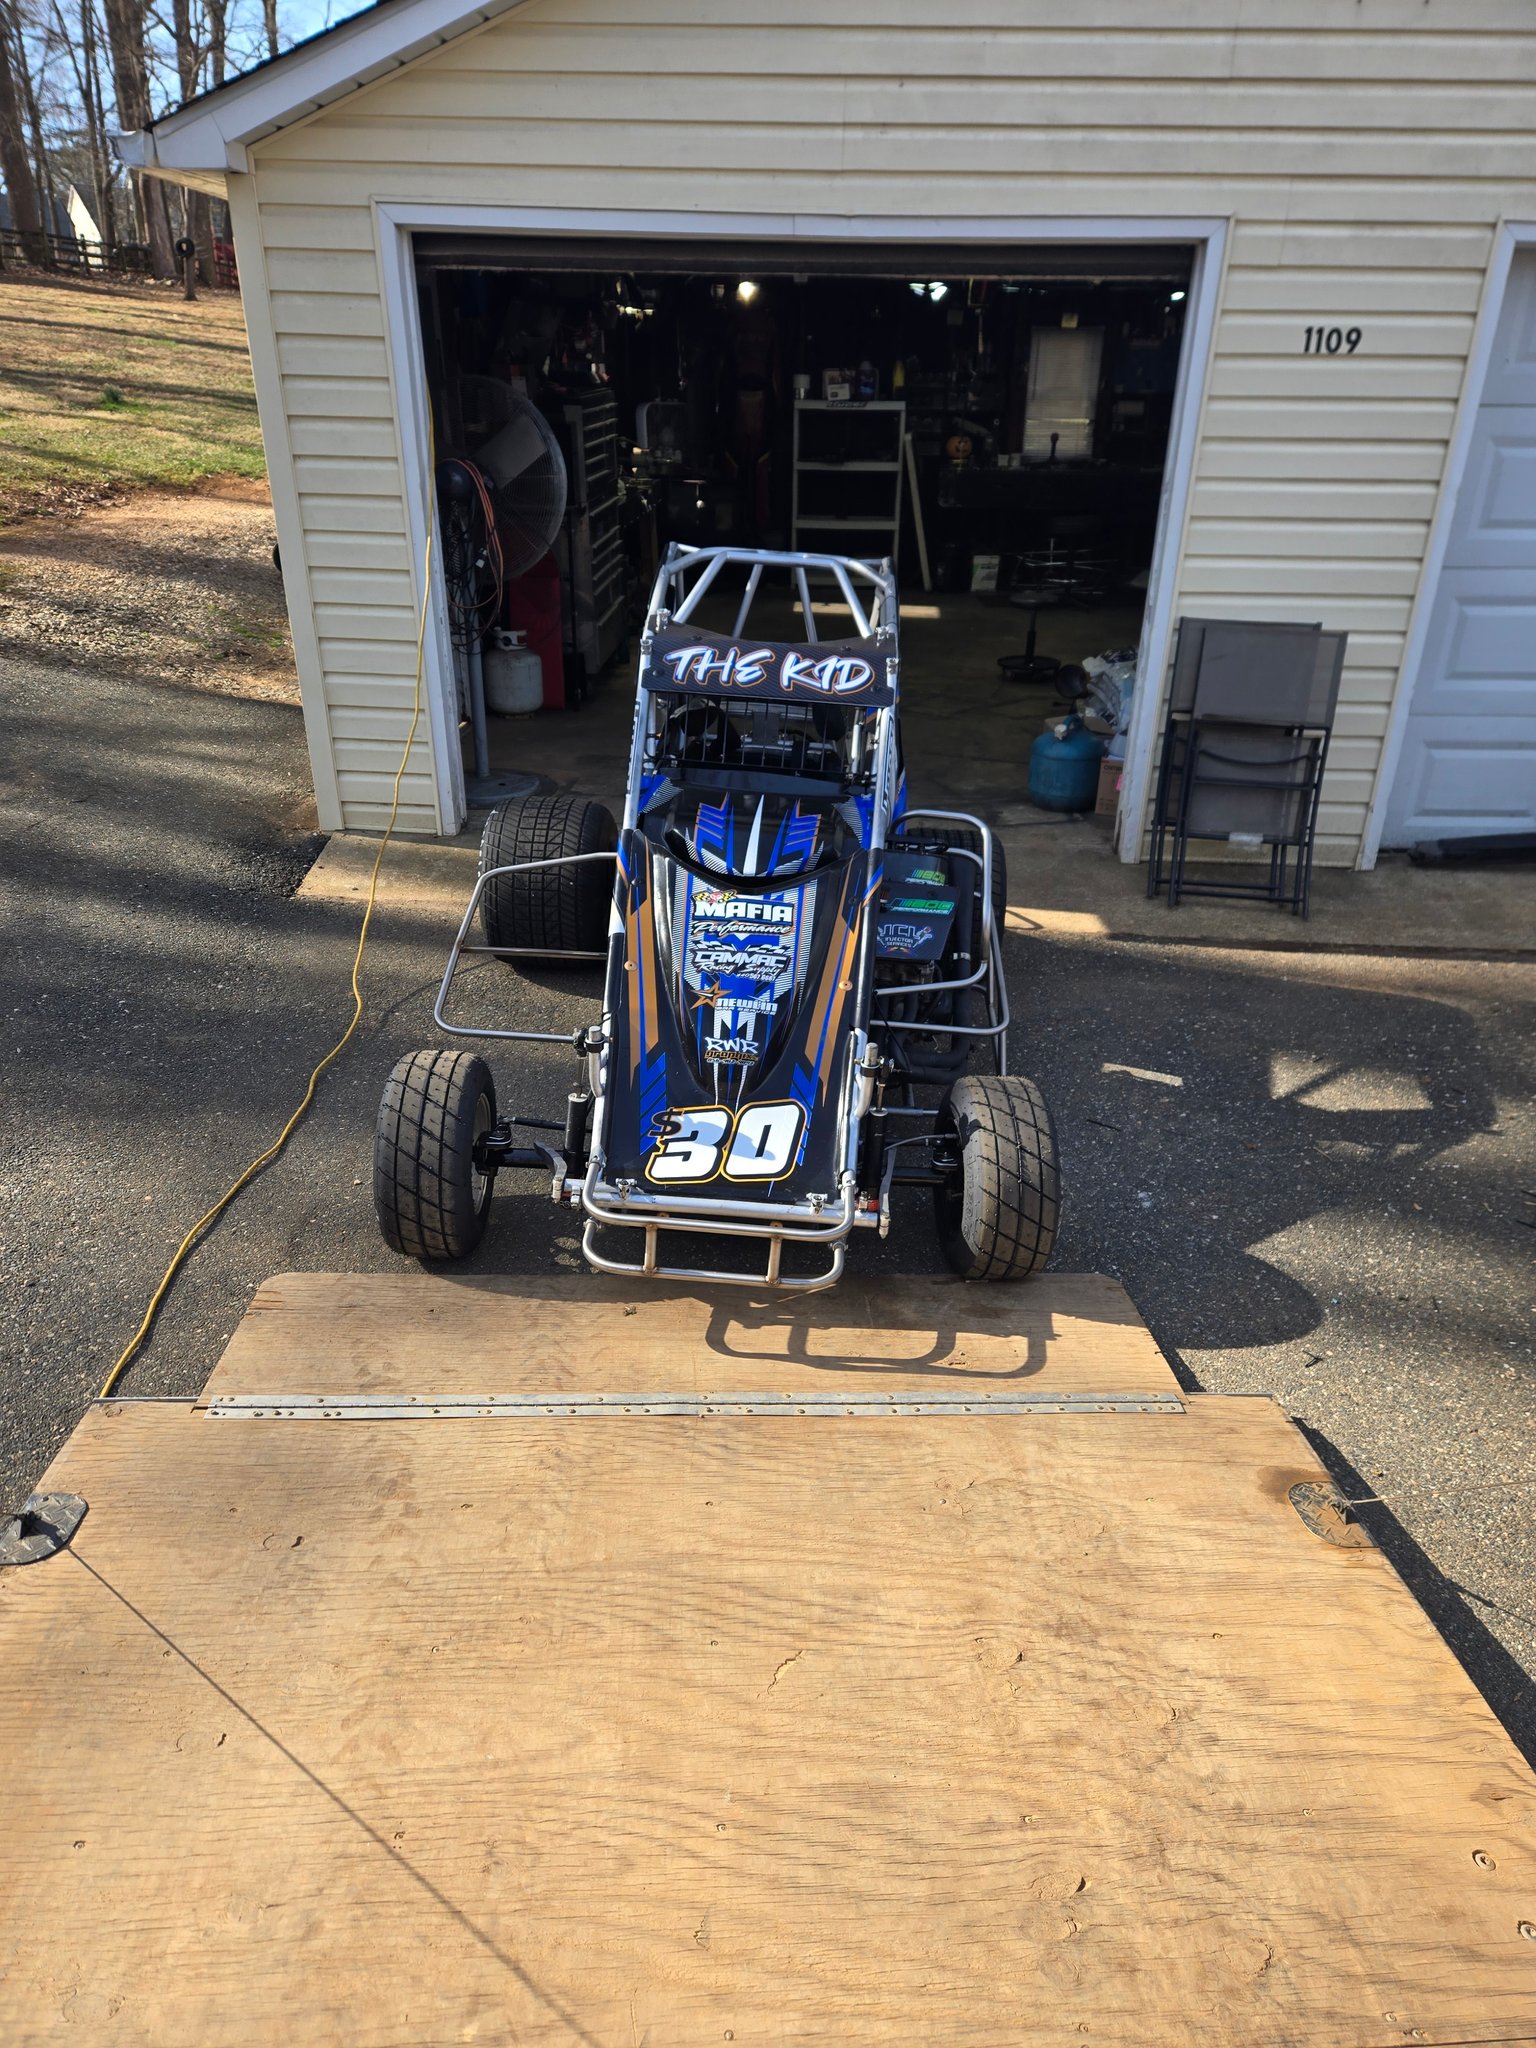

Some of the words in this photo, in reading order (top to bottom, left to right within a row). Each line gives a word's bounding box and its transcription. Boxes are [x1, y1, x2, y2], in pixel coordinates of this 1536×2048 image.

[1304, 326, 1362, 354] 1109
[663, 645, 774, 686] THE
[779, 651, 875, 695] KID
[694, 900, 793, 923] MAFIA
[692, 921, 792, 938] Performance
[694, 951, 787, 967] CAMMAC
[695, 962, 736, 974] Racing
[739, 963, 781, 978] Supply
[704, 1036, 759, 1054] RWR
